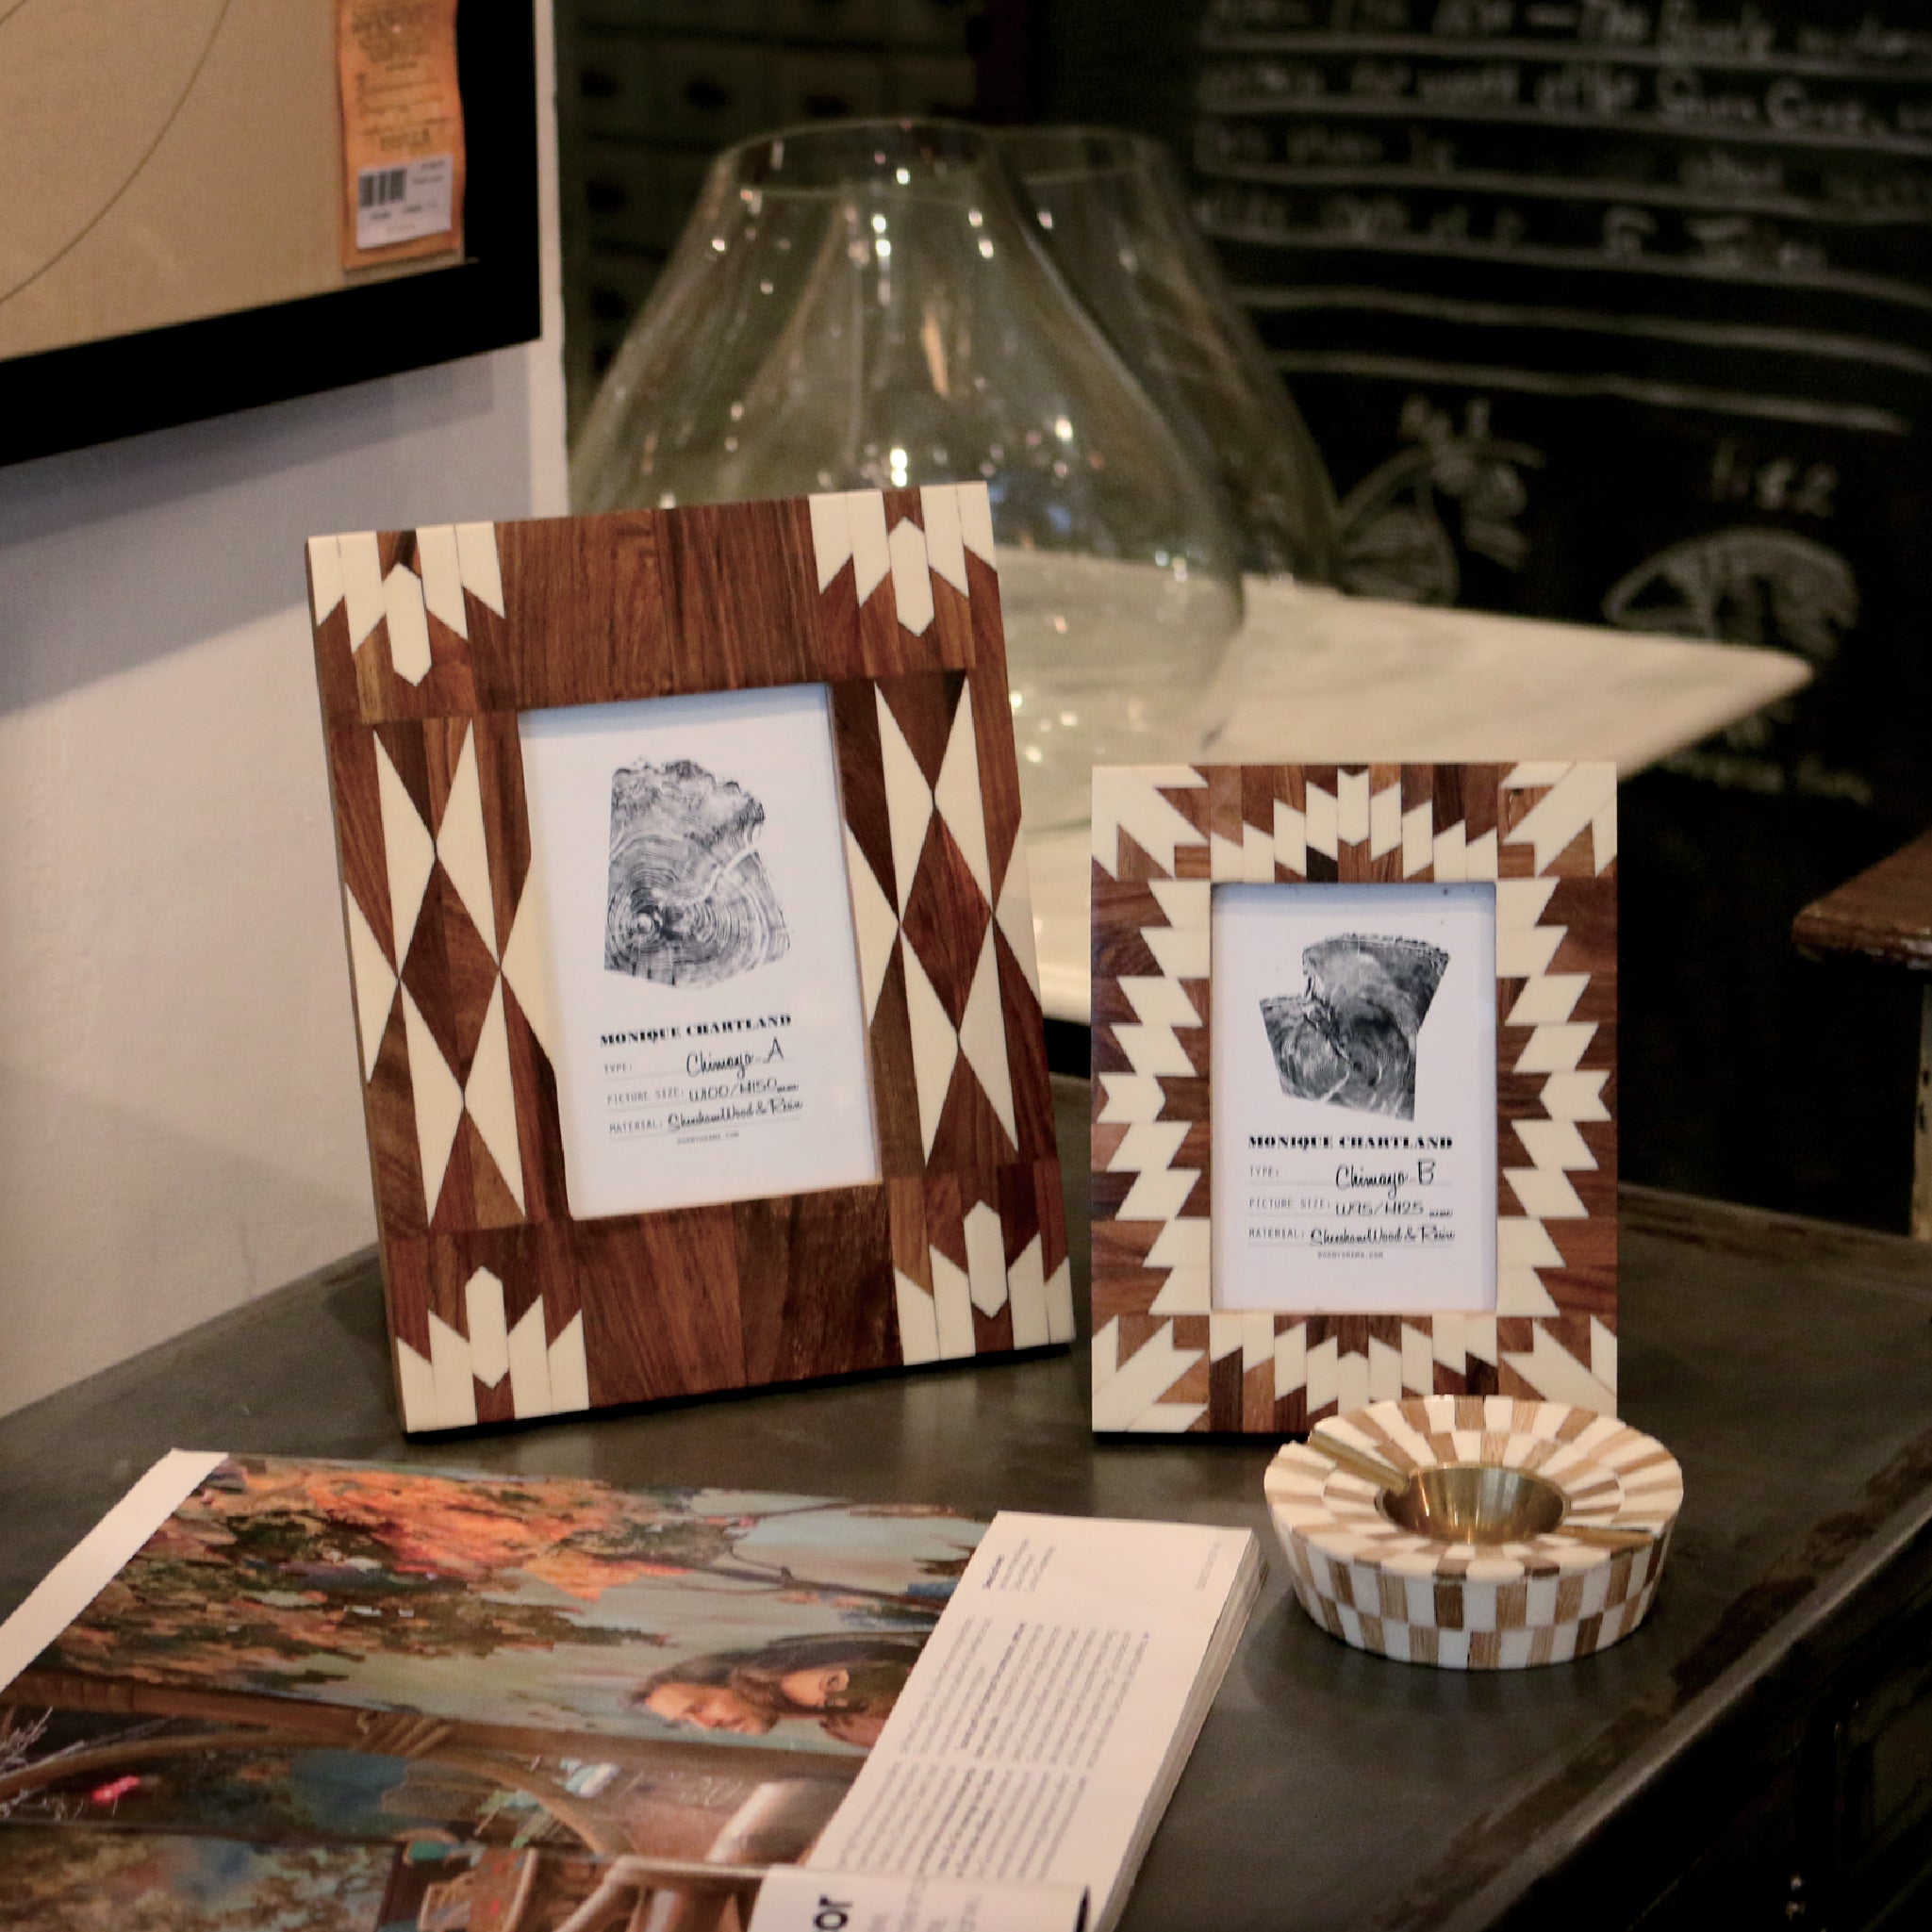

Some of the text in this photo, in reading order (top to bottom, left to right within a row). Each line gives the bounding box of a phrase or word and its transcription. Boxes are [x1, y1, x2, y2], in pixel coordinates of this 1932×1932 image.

[601, 1014, 792, 1046] MONIQUE CHARTLAND
[603, 1036, 784, 1079] TYPE: Chimayo A
[606, 1091, 649, 1105] PICTURE
[655, 1087, 685, 1100] SIZE:
[609, 1119, 664, 1135] MATERIAL:
[1247, 1135, 1453, 1150] MONIQUE CHARTLAND
[1248, 1158, 1437, 1199] TYPE: Chimayo B
[1248, 1198, 1293, 1210] PICTURE
[1300, 1198, 1331, 1211] SIZE:
[1248, 1229, 1305, 1241] MATERIAL:
